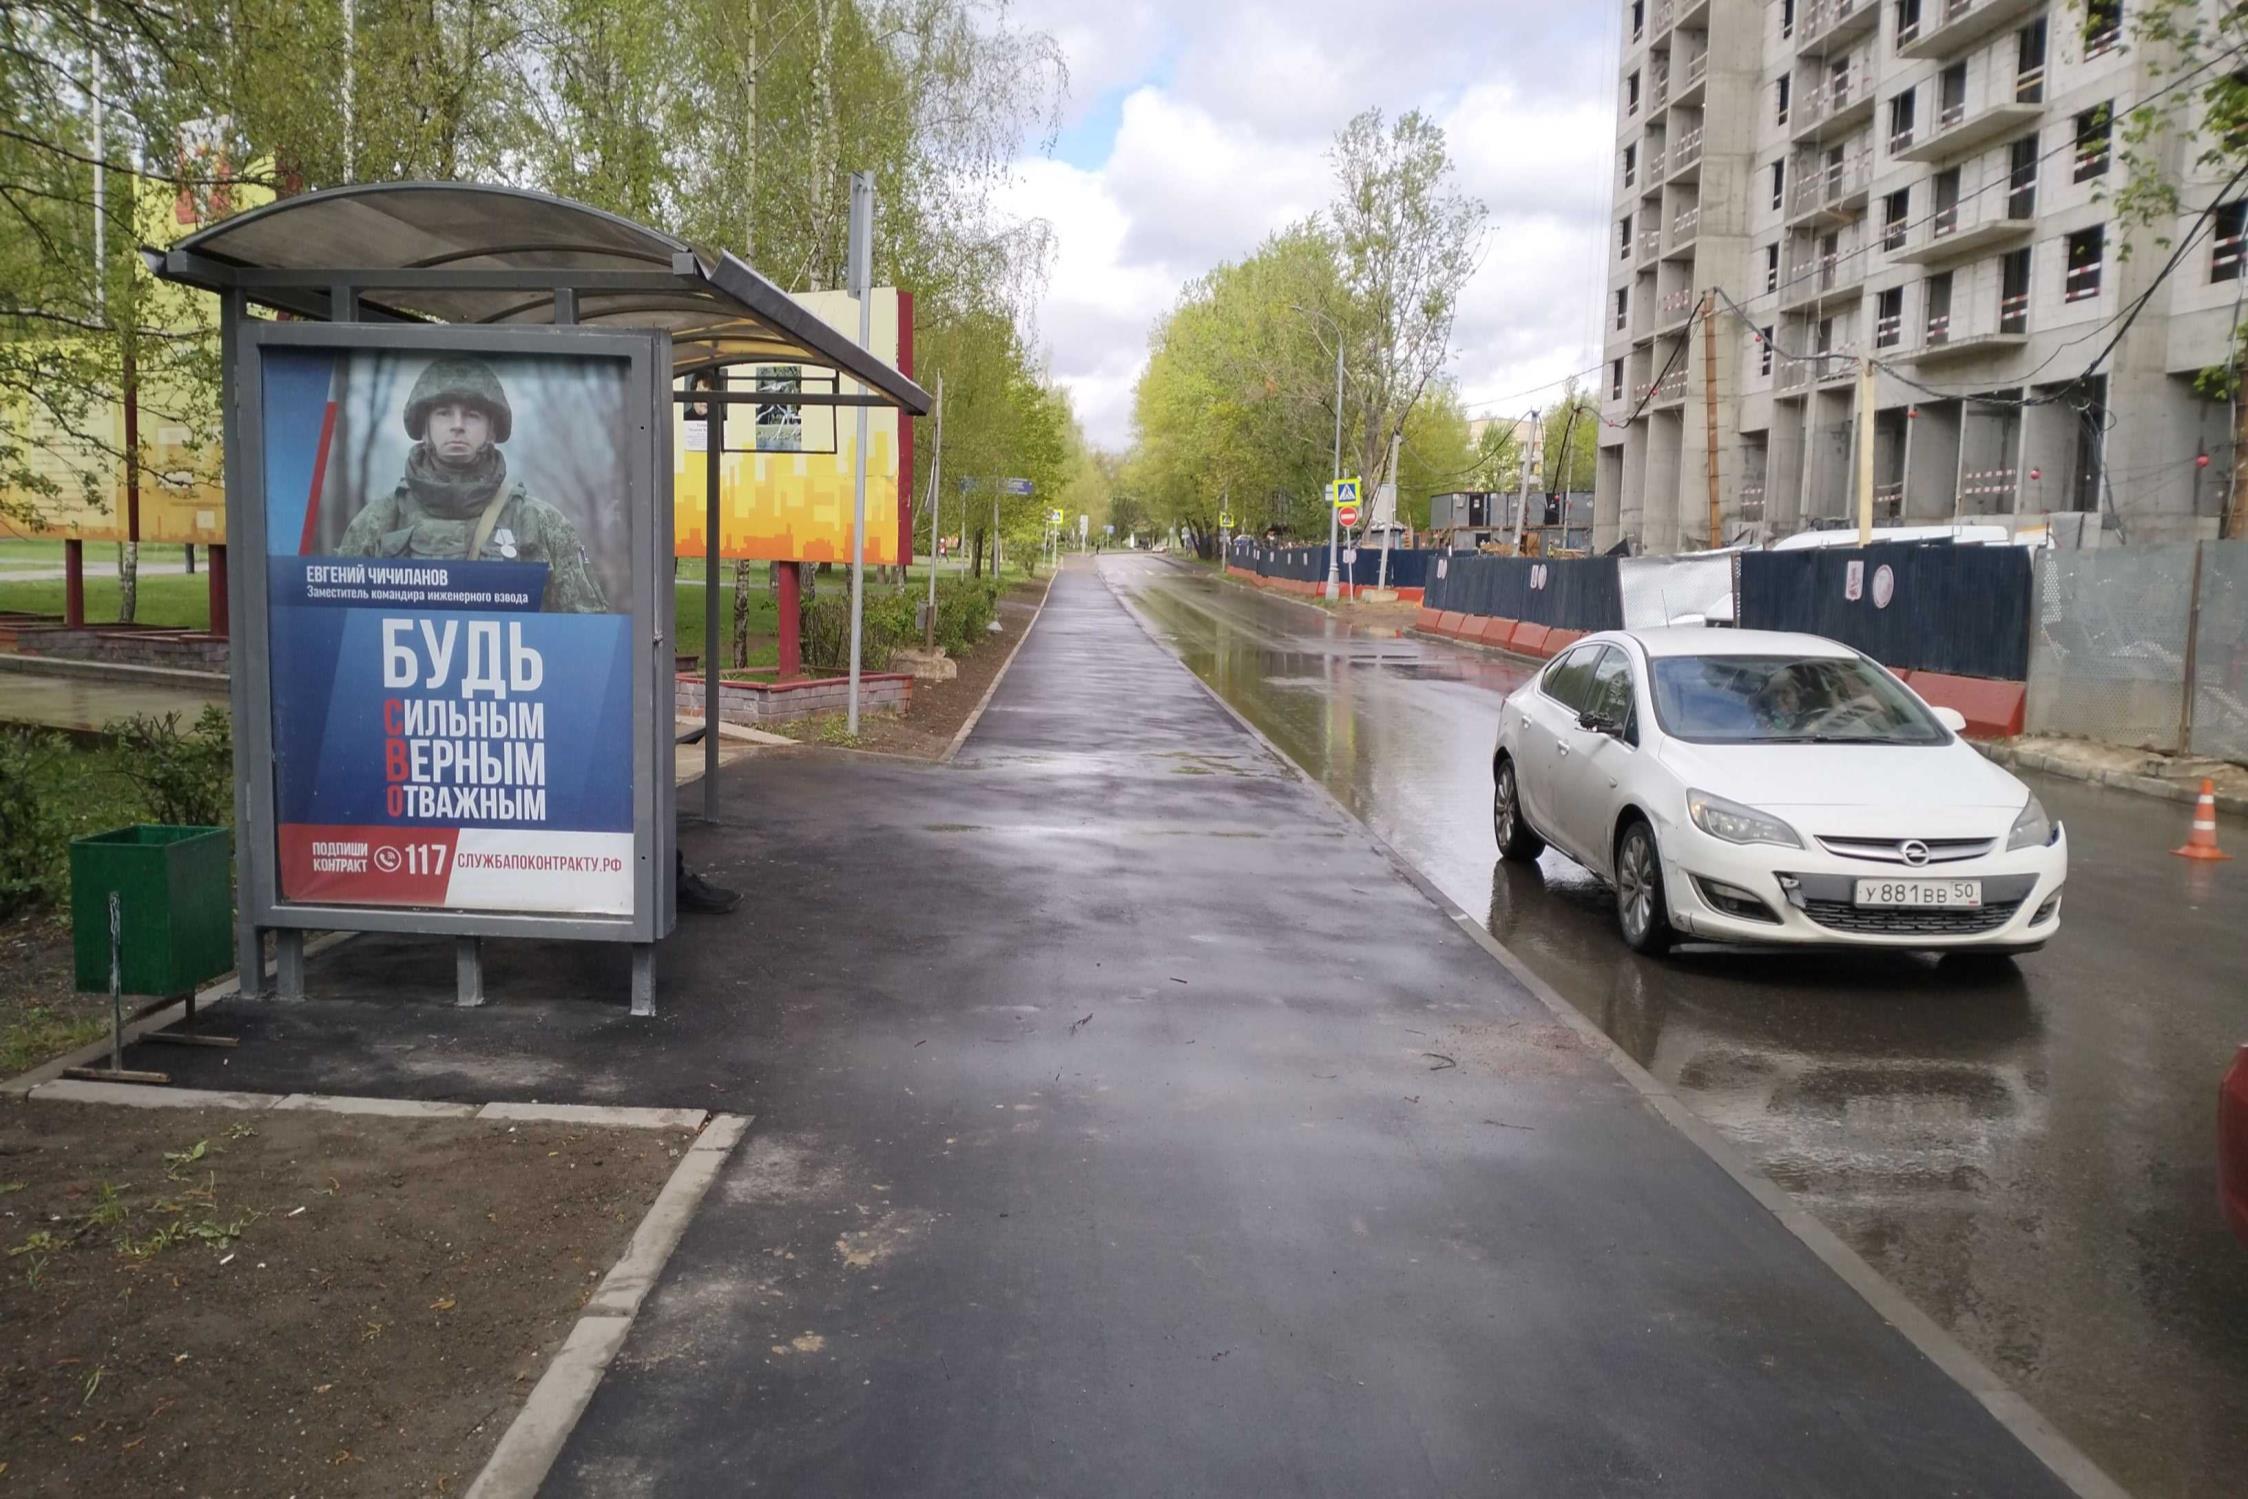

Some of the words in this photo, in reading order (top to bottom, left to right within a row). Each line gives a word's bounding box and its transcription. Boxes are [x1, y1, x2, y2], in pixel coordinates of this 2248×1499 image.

[306, 564, 365, 584] ЕВГЕНИЙ
[368, 567, 448, 586] ЧИЧИЛАНОВ
[307, 585, 369, 599] Заместитель
[371, 589, 425, 602] командира
[427, 591, 491, 604] инженерного
[494, 593, 528, 604] взвода
[382, 618, 544, 699] БУДЬ
[384, 698, 544, 739] СИЛЬНЫМ
[385, 738, 546, 785] ВЕРНЫМ
[387, 785, 546, 820] ОТВАЖНЫМ
[312, 842, 368, 857] ПОДПИШИ
[405, 844, 447, 875] 117
[312, 858, 367, 873] КОНТРАКТ
[457, 852, 622, 873] СЛУЖБАПОКОНТРАКТУ.РФ
[1954, 883, 1974, 898] 50
